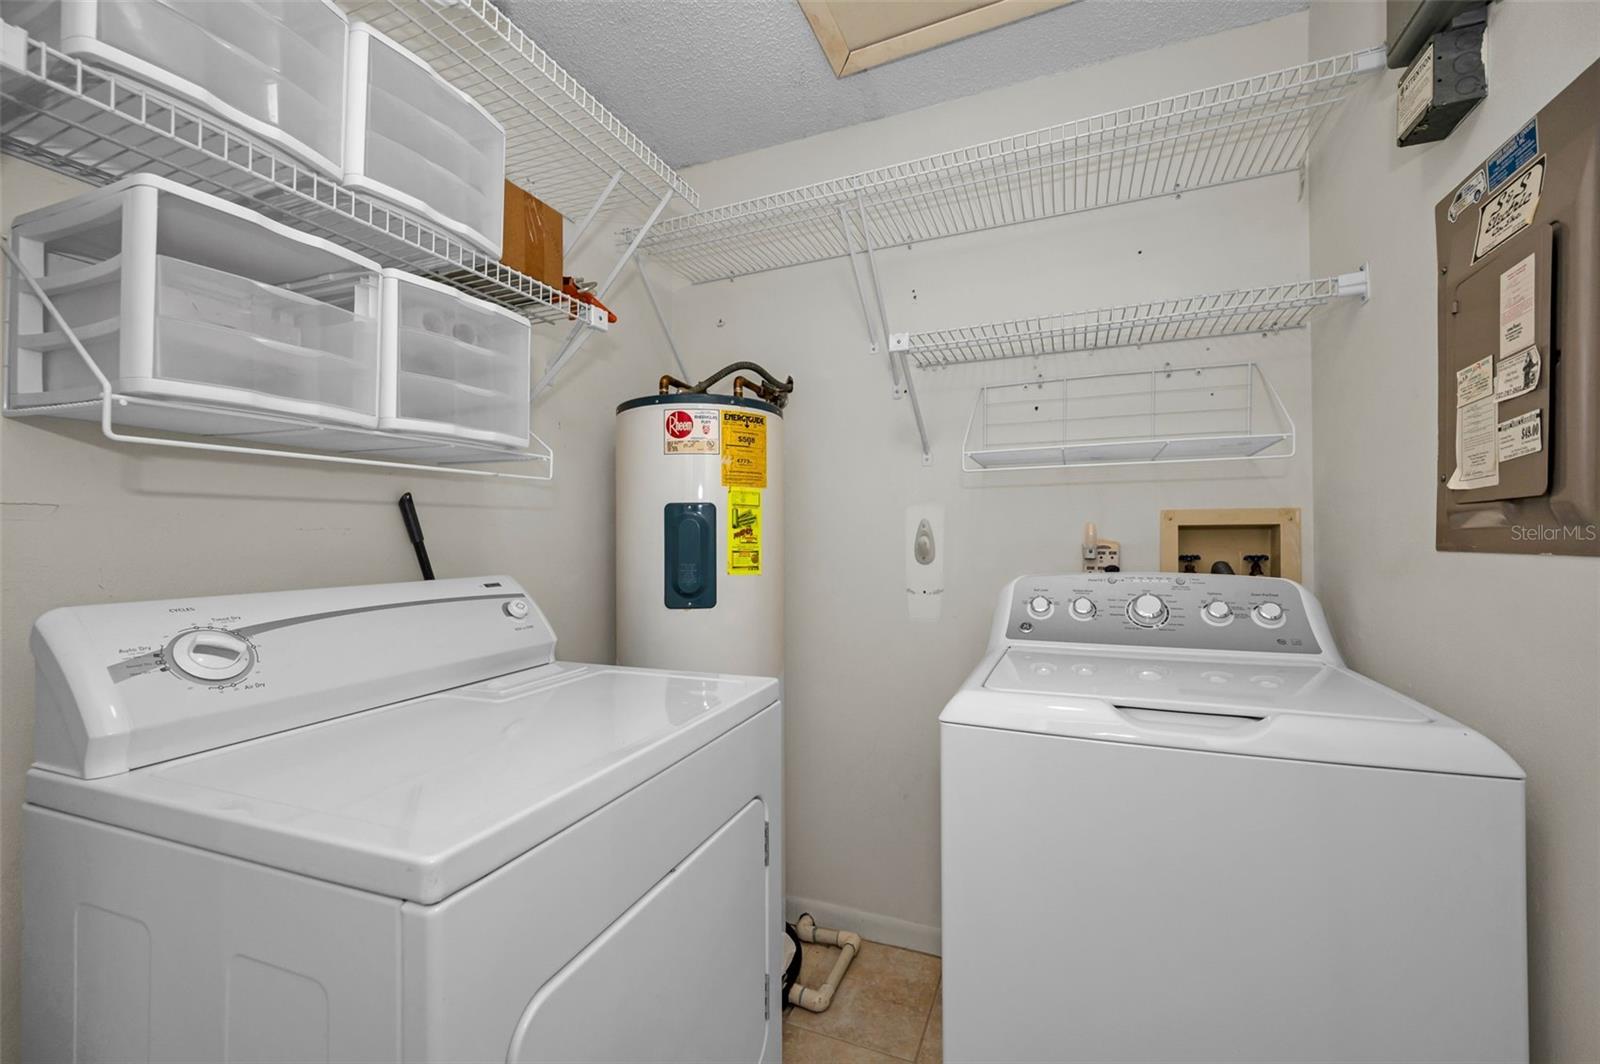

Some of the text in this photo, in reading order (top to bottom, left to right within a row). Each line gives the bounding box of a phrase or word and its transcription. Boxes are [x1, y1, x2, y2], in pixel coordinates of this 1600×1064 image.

[1405, 53, 1432, 91] ATTENTION
[669, 412, 693, 436] Rheem
[168, 606, 196, 614] CYCLES
